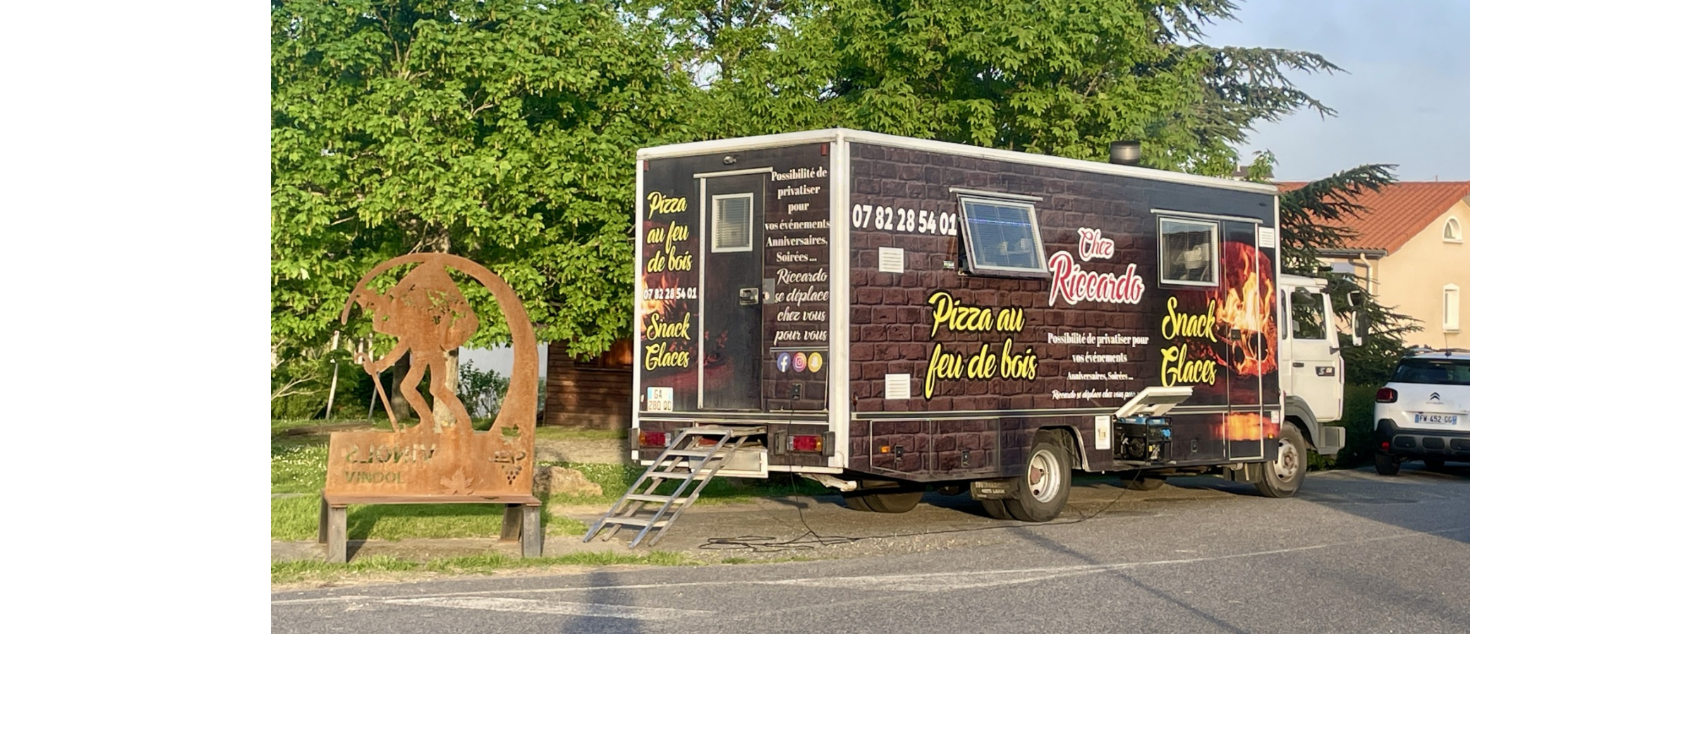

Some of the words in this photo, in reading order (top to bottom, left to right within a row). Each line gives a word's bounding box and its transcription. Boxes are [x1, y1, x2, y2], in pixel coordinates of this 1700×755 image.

[772, 167, 815, 181] Possibilité
[816, 166, 828, 178] de
[778, 184, 820, 199] privatiser
[647, 191, 687, 219] Pizza
[788, 203, 809, 215] pour
[765, 223, 778, 231] vos
[780, 219, 830, 230] événements
[852, 204, 872, 228] 07
[875, 205, 893, 230] 82
[897, 208, 915, 232] 28
[918, 210, 936, 234] 54
[940, 212, 957, 236] 01
[647, 228, 665, 244] au
[666, 220, 689, 254] feu
[766, 235, 828, 247] Anniversaires,
[1077, 227, 1114, 261] Chez
[648, 250, 665, 272] de
[668, 245, 692, 270] bois
[777, 268, 828, 285] Riccardo
[1048, 250, 1145, 306] Riccardo
[643, 288, 653, 300] 07
[654, 288, 664, 299] 82
[665, 288, 674, 299] 28
[676, 288, 686, 299] 54
[687, 287, 697, 299] 01
[775, 292, 785, 303] se
[786, 285, 829, 307] déplace
[777, 306, 800, 321] chez
[802, 311, 826, 321] vous
[928, 292, 994, 338] Pizza
[996, 307, 1025, 332] au
[1162, 296, 1218, 342] Snack
[647, 312, 691, 340] Snack
[774, 330, 801, 346] pour
[804, 330, 828, 341] vous
[1047, 332, 1086, 344] Possibilité
[1086, 332, 1096, 344] de
[1097, 333, 1131, 347] privatiser
[1132, 336, 1149, 347] pour
[645, 342, 690, 371] Glaces
[925, 343, 964, 399] feu
[967, 344, 997, 378] de
[1001, 338, 1038, 380] bois
[1072, 354, 1084, 363] vos
[1085, 351, 1128, 363] événements
[1161, 343, 1217, 387] Glaces
